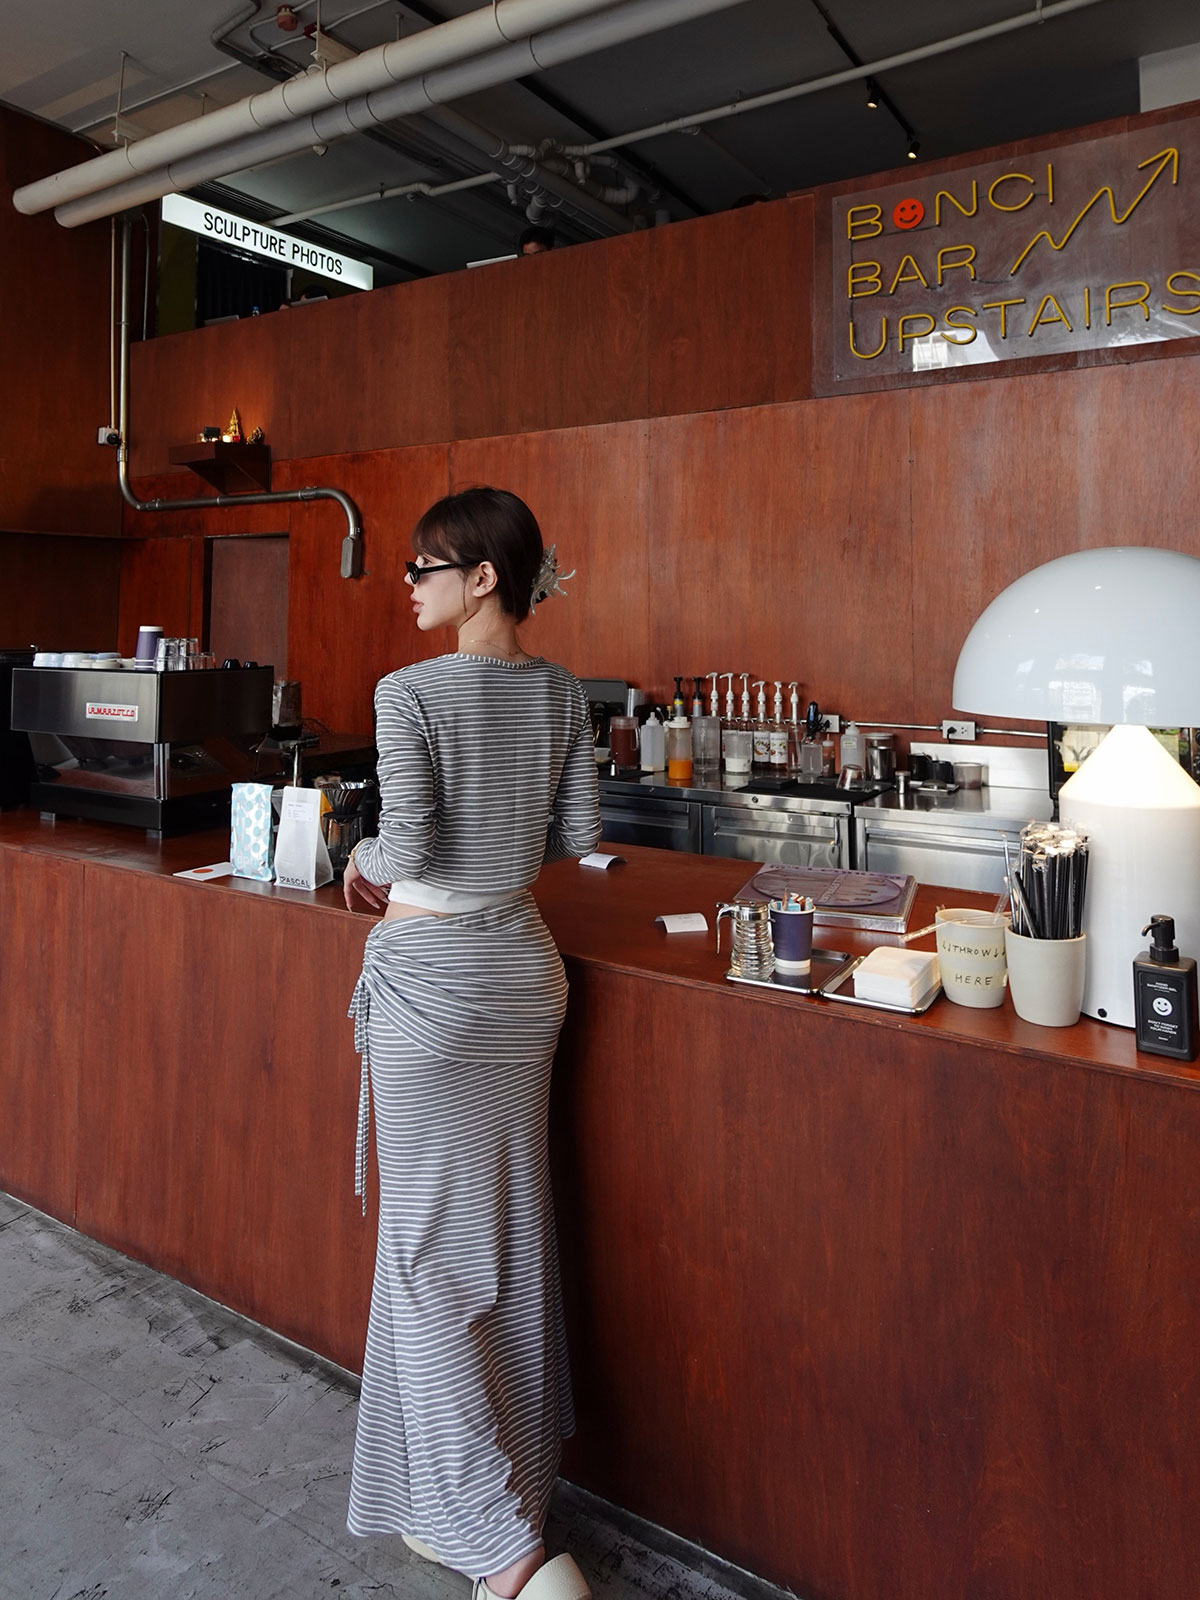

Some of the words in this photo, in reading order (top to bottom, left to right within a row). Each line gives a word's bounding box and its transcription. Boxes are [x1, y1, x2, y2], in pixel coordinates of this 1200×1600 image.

[203, 212, 287, 257] SCULPTURE
[291, 243, 344, 276] PHOTOS
[847, 244, 977, 299] BAR
[849, 271, 1200, 360] UPSTAIRS
[952, 944, 992, 957] THROW
[954, 973, 993, 986] HERE
